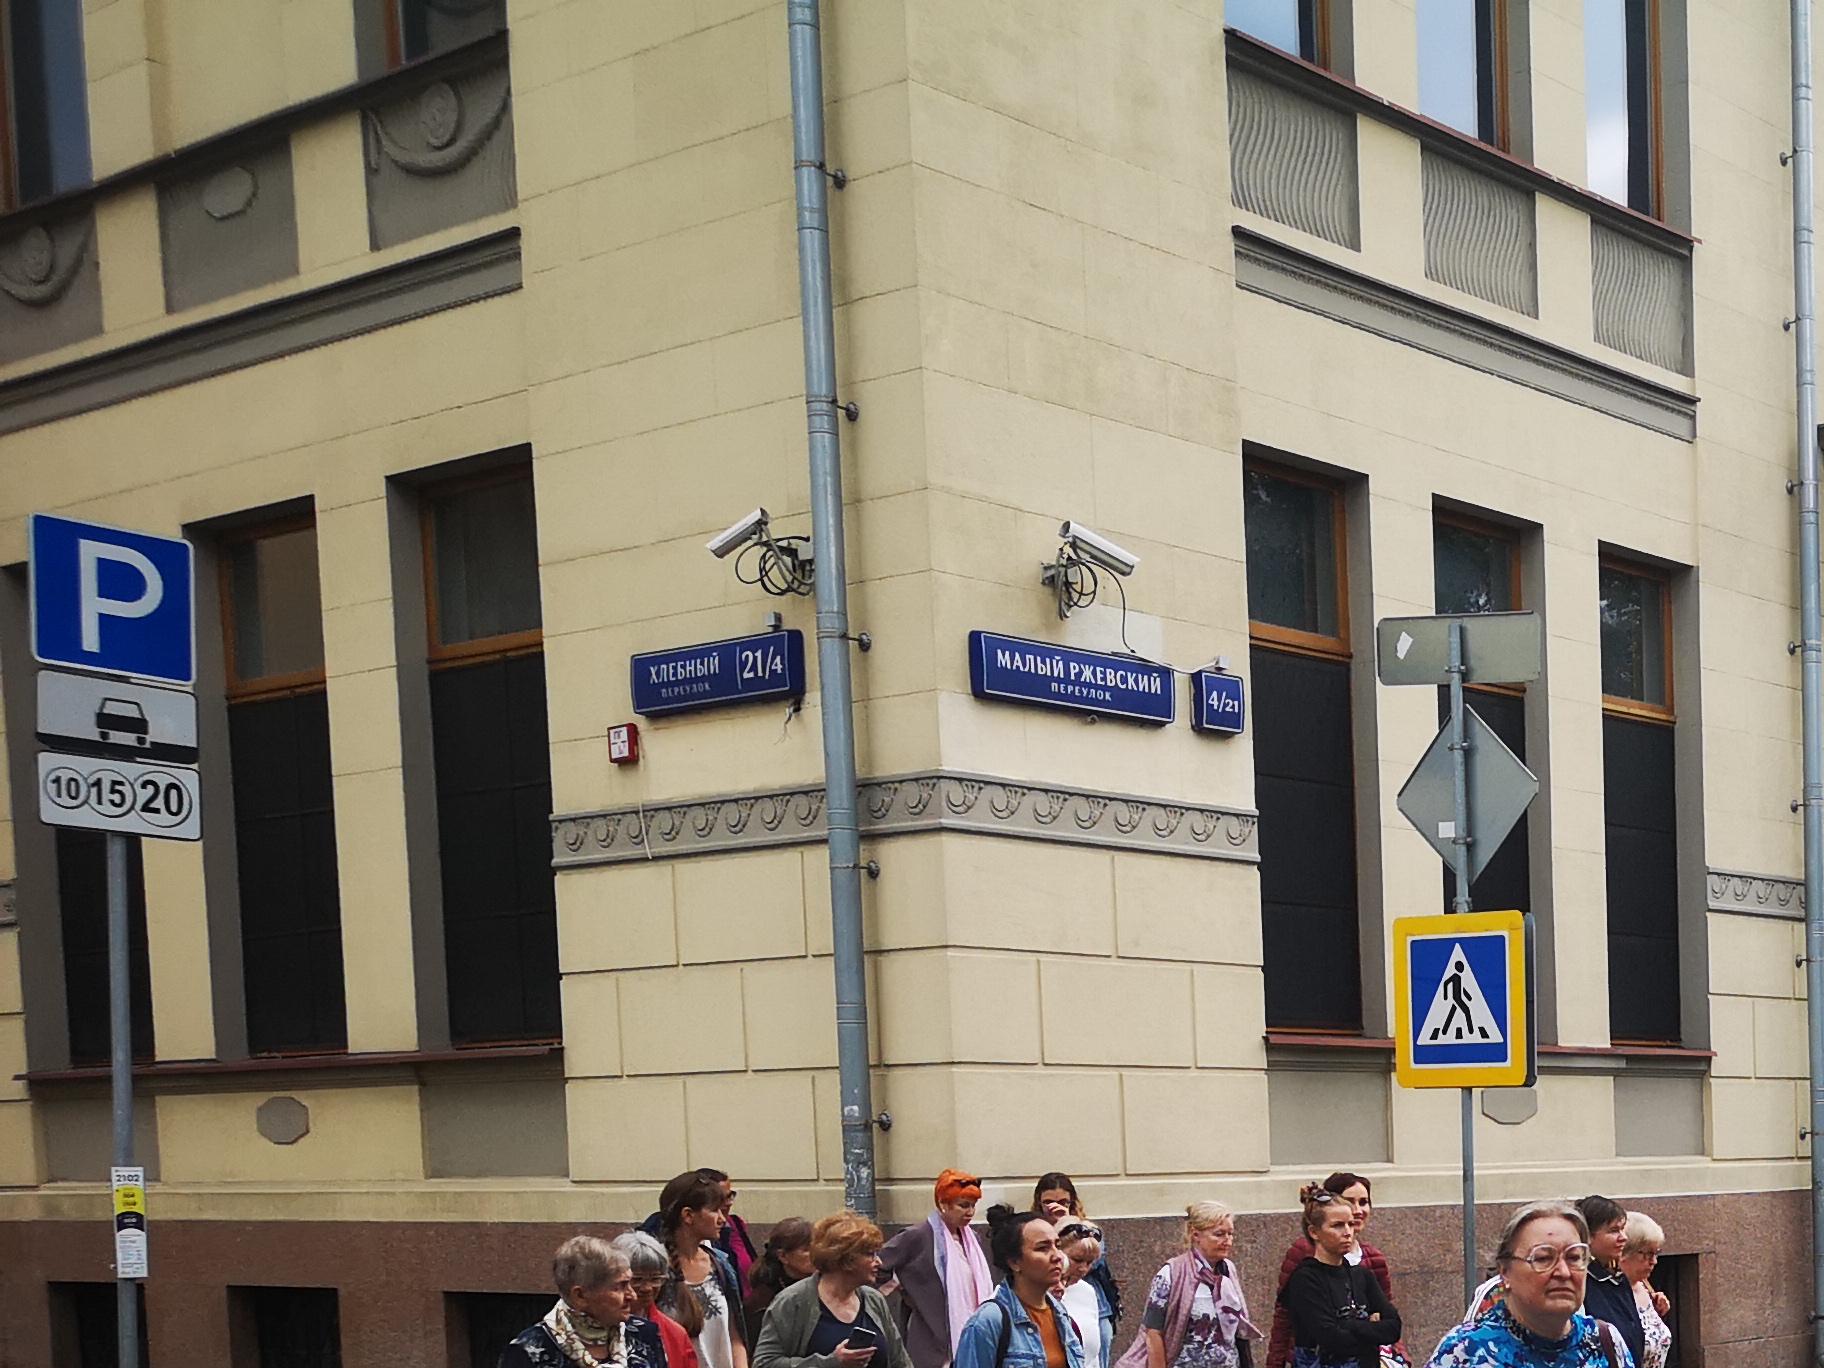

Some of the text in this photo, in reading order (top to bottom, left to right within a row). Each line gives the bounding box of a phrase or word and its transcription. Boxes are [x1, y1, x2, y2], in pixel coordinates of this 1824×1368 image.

[79, 538, 163, 653] P
[649, 652, 720, 684] ХЛЕБНЫЙ
[742, 645, 783, 679] 21/4
[996, 649, 1162, 695] МАЛЫЙ РЖЕВСКИЙ
[661, 683, 711, 698] ПЕРЕУЛОК
[1050, 682, 1112, 702] ПЕРЕУЛОК
[1208, 690, 1239, 714] 4/21
[51, 775, 184, 817] 10 15 20
